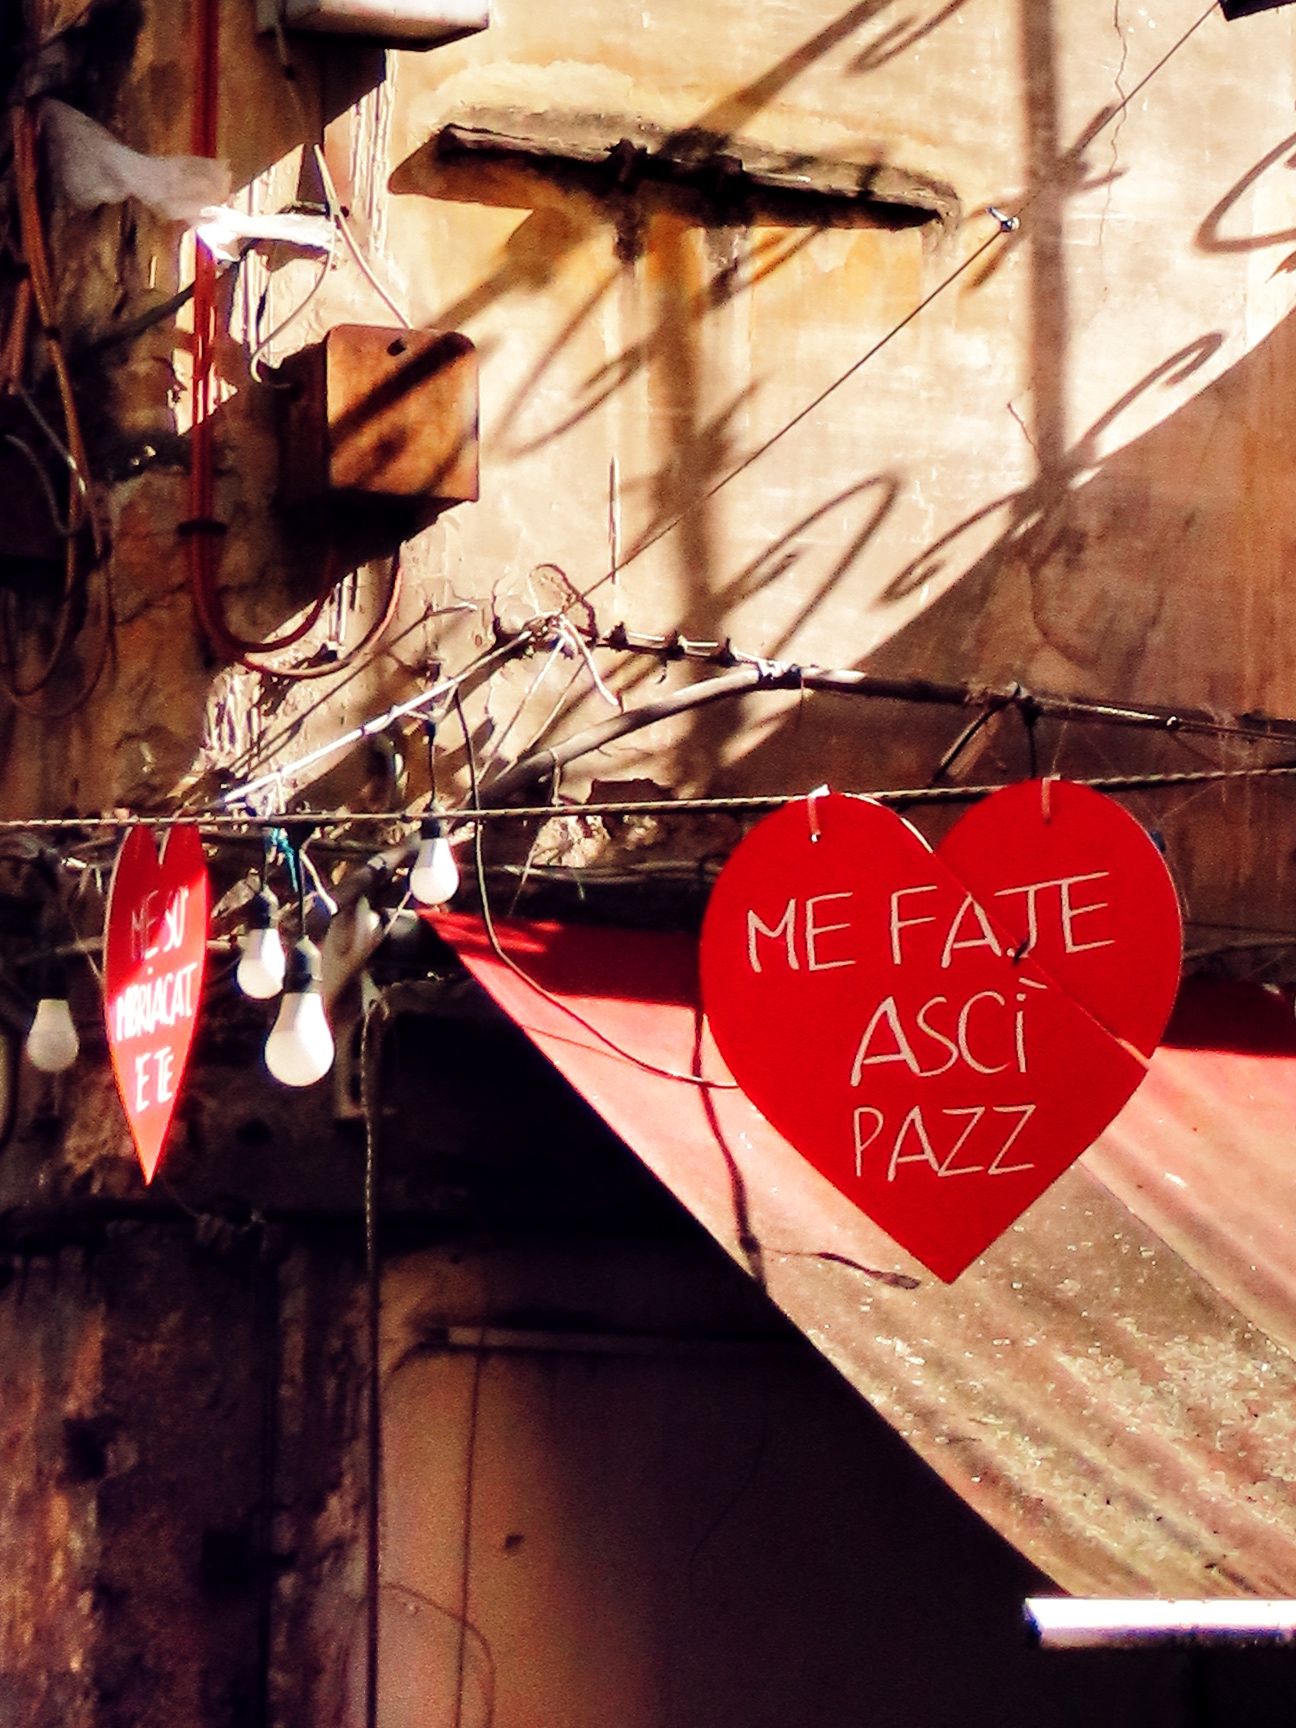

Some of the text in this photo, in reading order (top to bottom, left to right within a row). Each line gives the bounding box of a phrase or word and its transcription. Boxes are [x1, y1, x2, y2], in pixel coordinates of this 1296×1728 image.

[747, 872, 1115, 973] ME FAJE
[135, 1046, 175, 1113] E TE
[853, 1105, 1037, 1182] PAZZ
